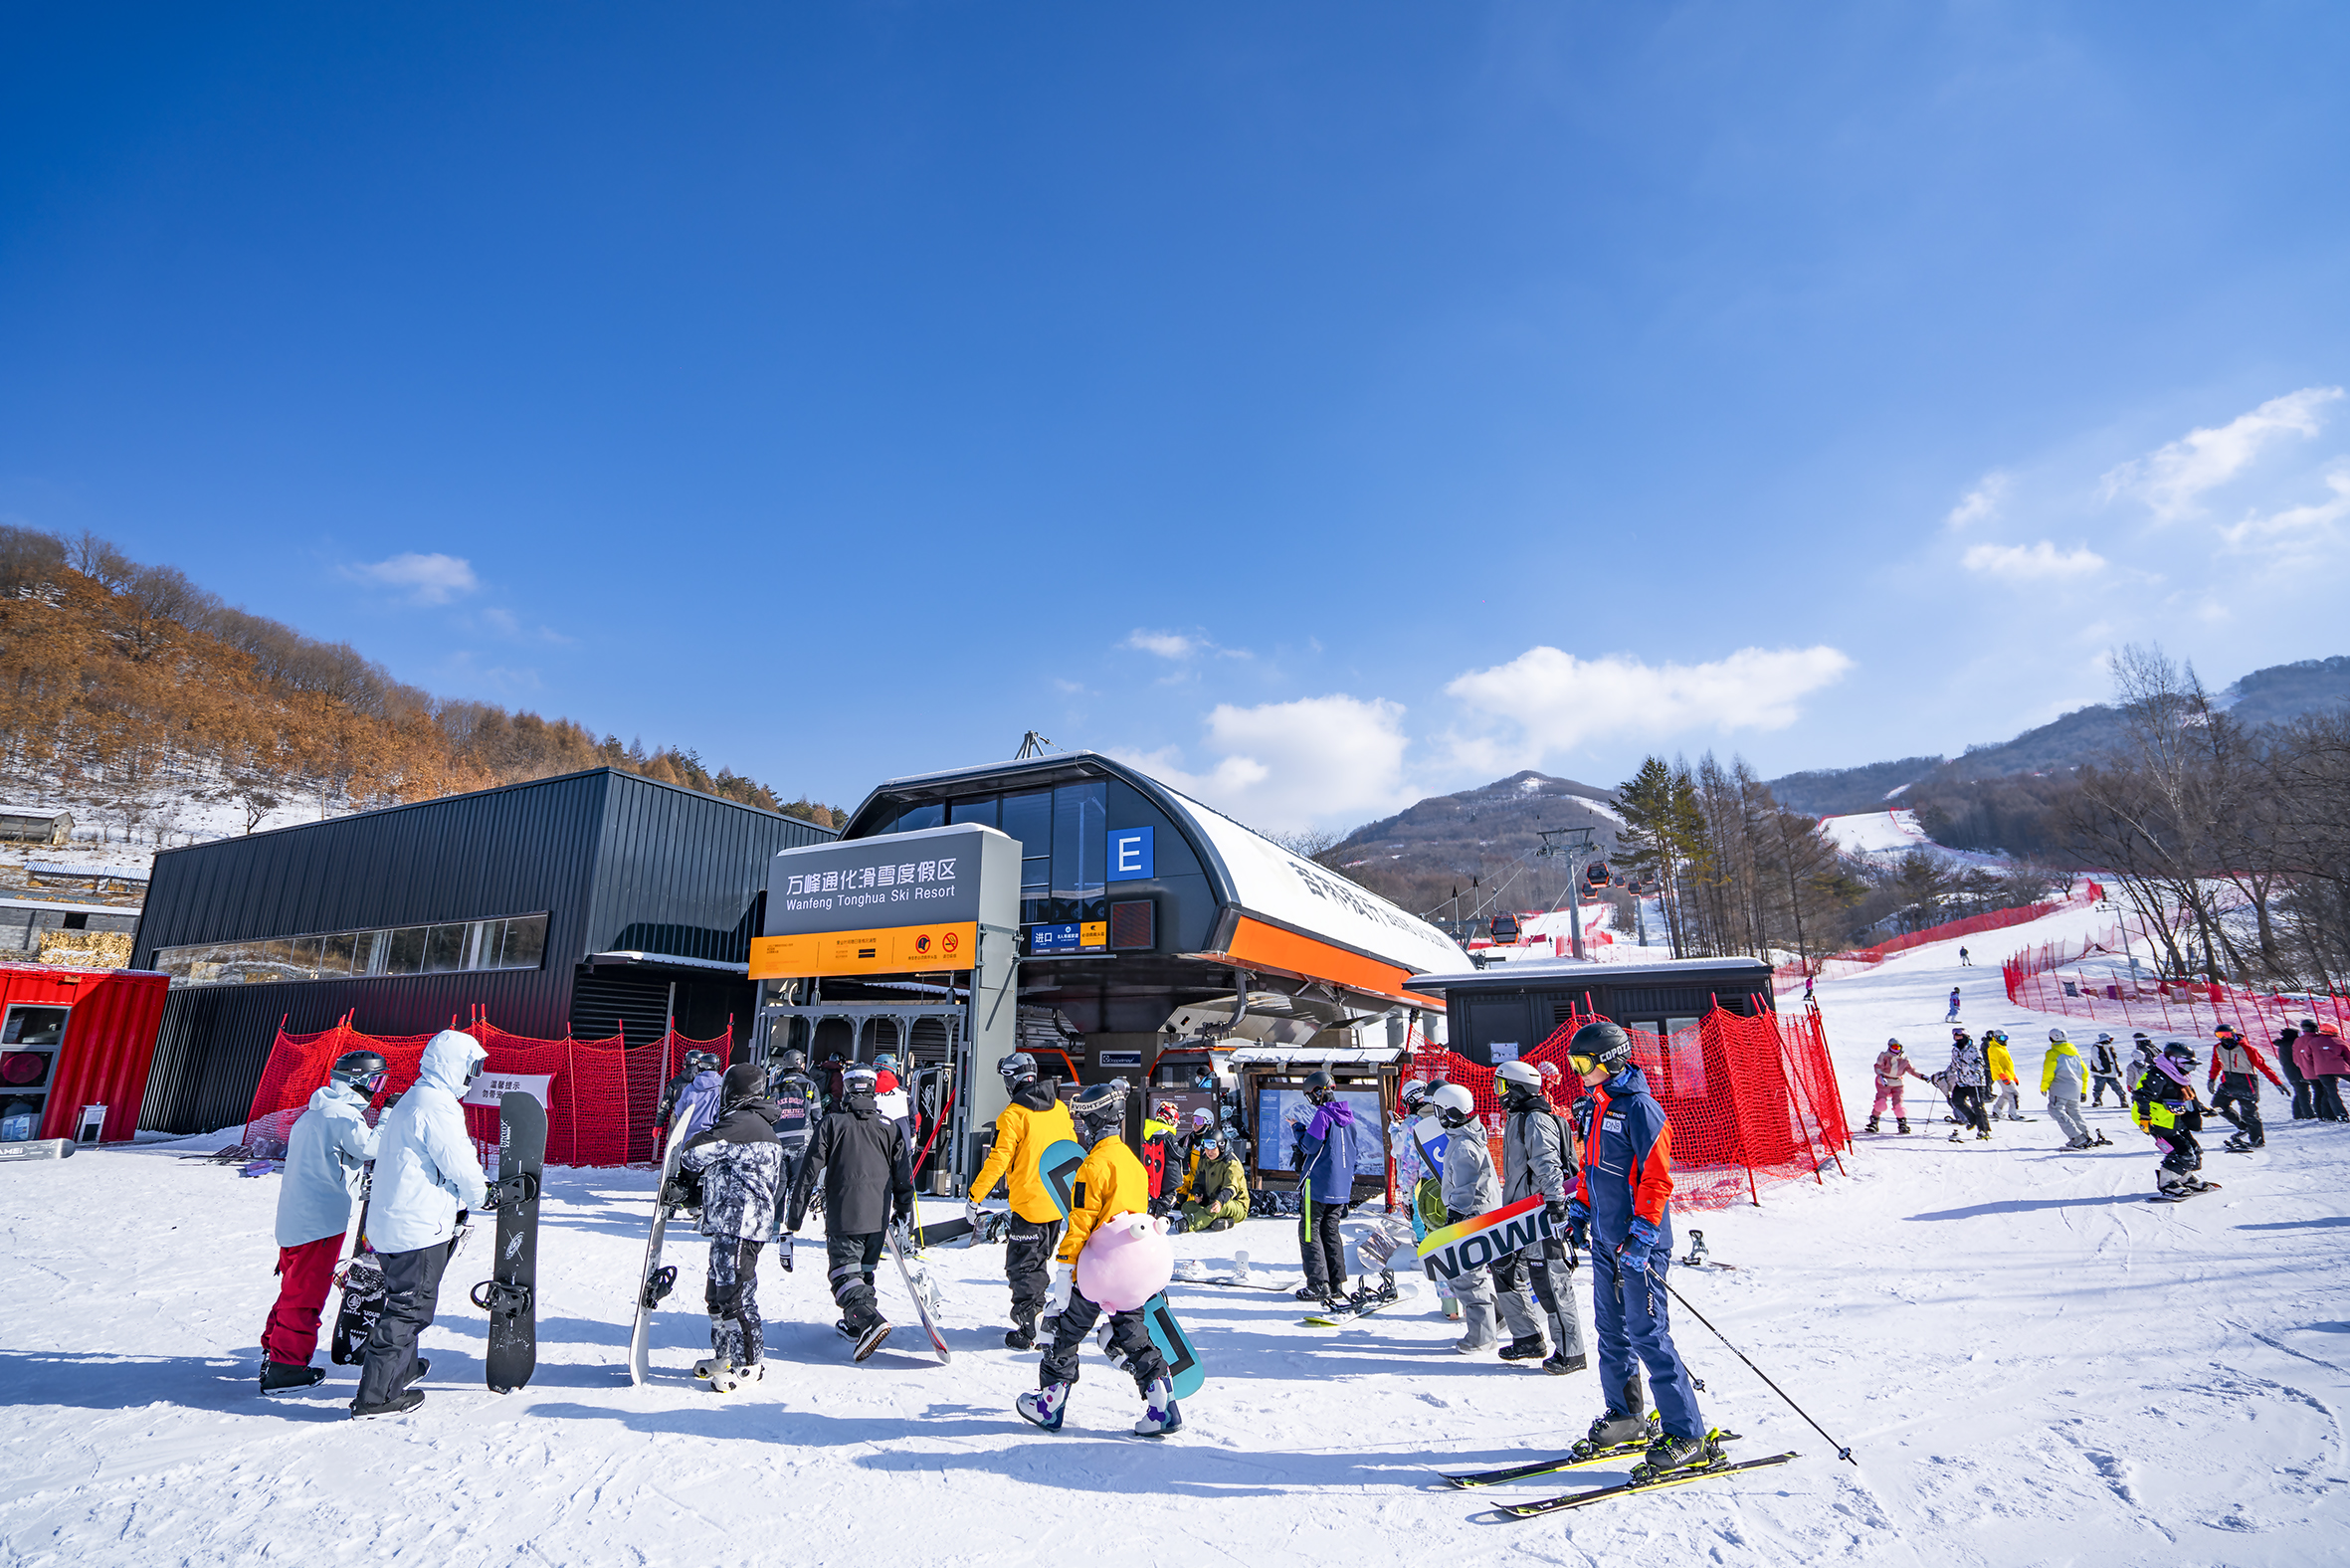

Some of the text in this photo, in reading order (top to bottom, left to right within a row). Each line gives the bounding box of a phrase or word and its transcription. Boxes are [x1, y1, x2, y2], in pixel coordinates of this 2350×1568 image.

[1118, 836, 1142, 872] E
[786, 858, 957, 895] 万峰通化滑雪度假区
[786, 884, 955, 911] Wanfeng Tonghua Ski Resort
[1035, 932, 1053, 943] 进口
[482, 1089, 506, 1099] 勿带宠
[490, 1079, 521, 1090] 温馨提示
